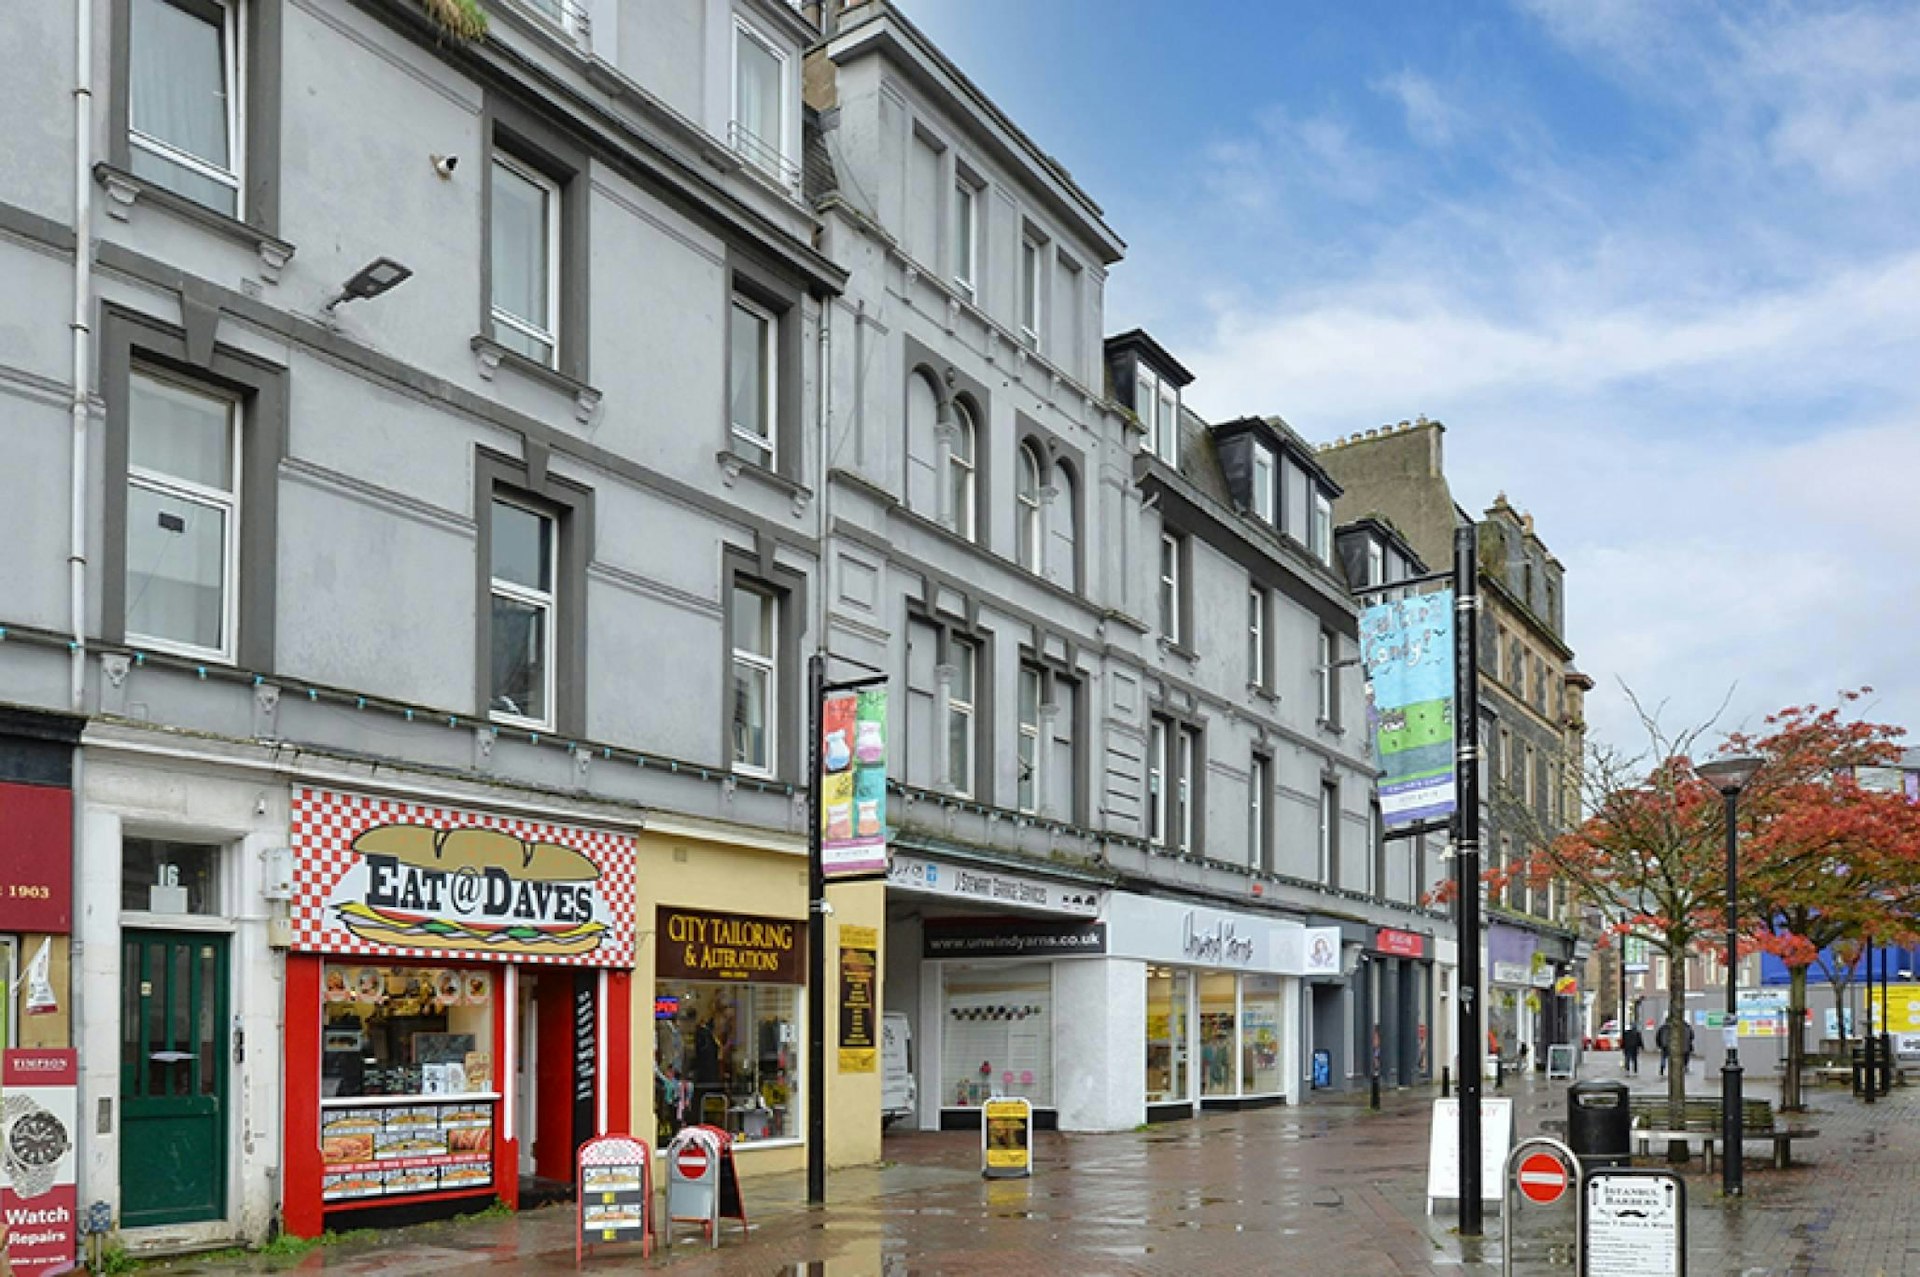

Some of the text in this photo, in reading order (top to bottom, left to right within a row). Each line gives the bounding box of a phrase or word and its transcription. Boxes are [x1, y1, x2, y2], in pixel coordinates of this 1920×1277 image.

[8, 885, 50, 898] 1903
[669, 914, 793, 950] CITY TAILORING
[684, 944, 779, 971] & ALTERATIONS
[4, 1206, 69, 1225] Watch
[9, 1229, 67, 1247] Repairs
